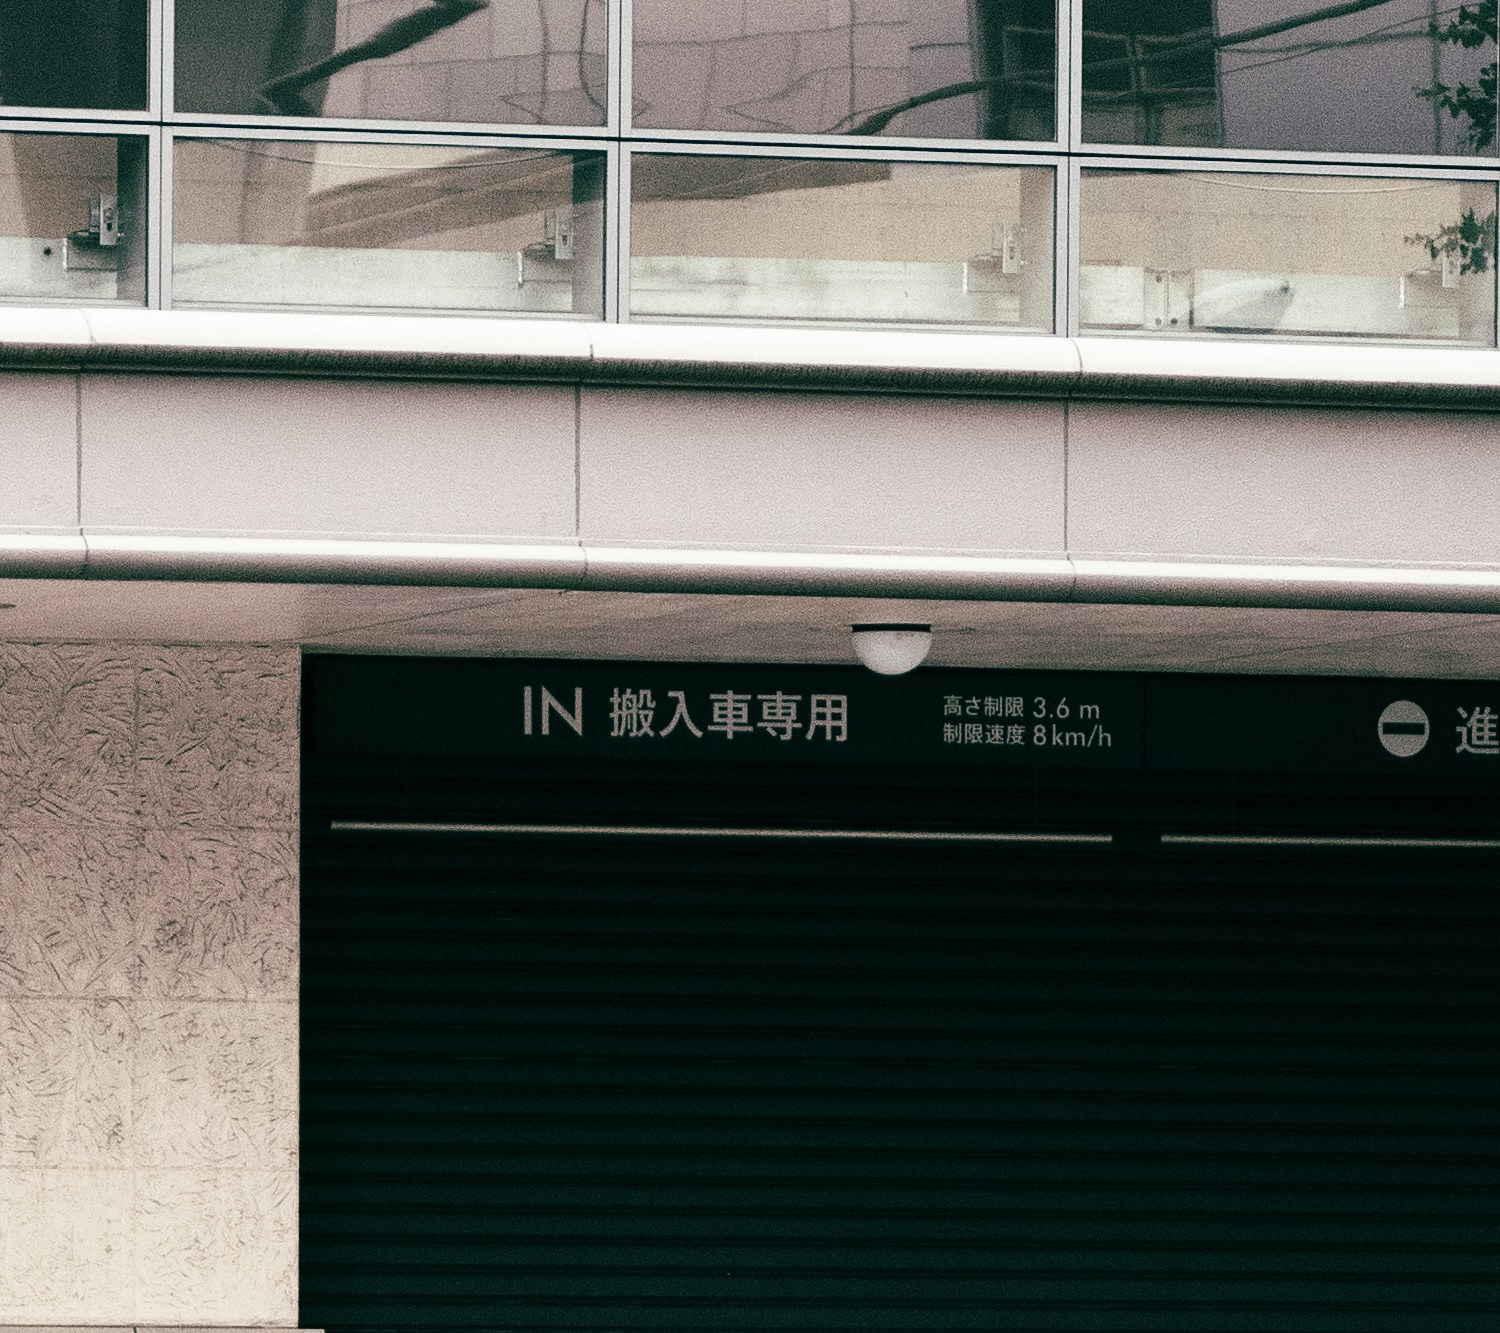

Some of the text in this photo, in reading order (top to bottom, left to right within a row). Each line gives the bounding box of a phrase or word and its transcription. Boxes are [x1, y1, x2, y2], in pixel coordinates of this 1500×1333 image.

[523, 685, 848, 742] IN 搬入車専用
[943, 694, 1101, 720] 高さ制限 3.6 m
[943, 722, 1025, 745] 制限速度
